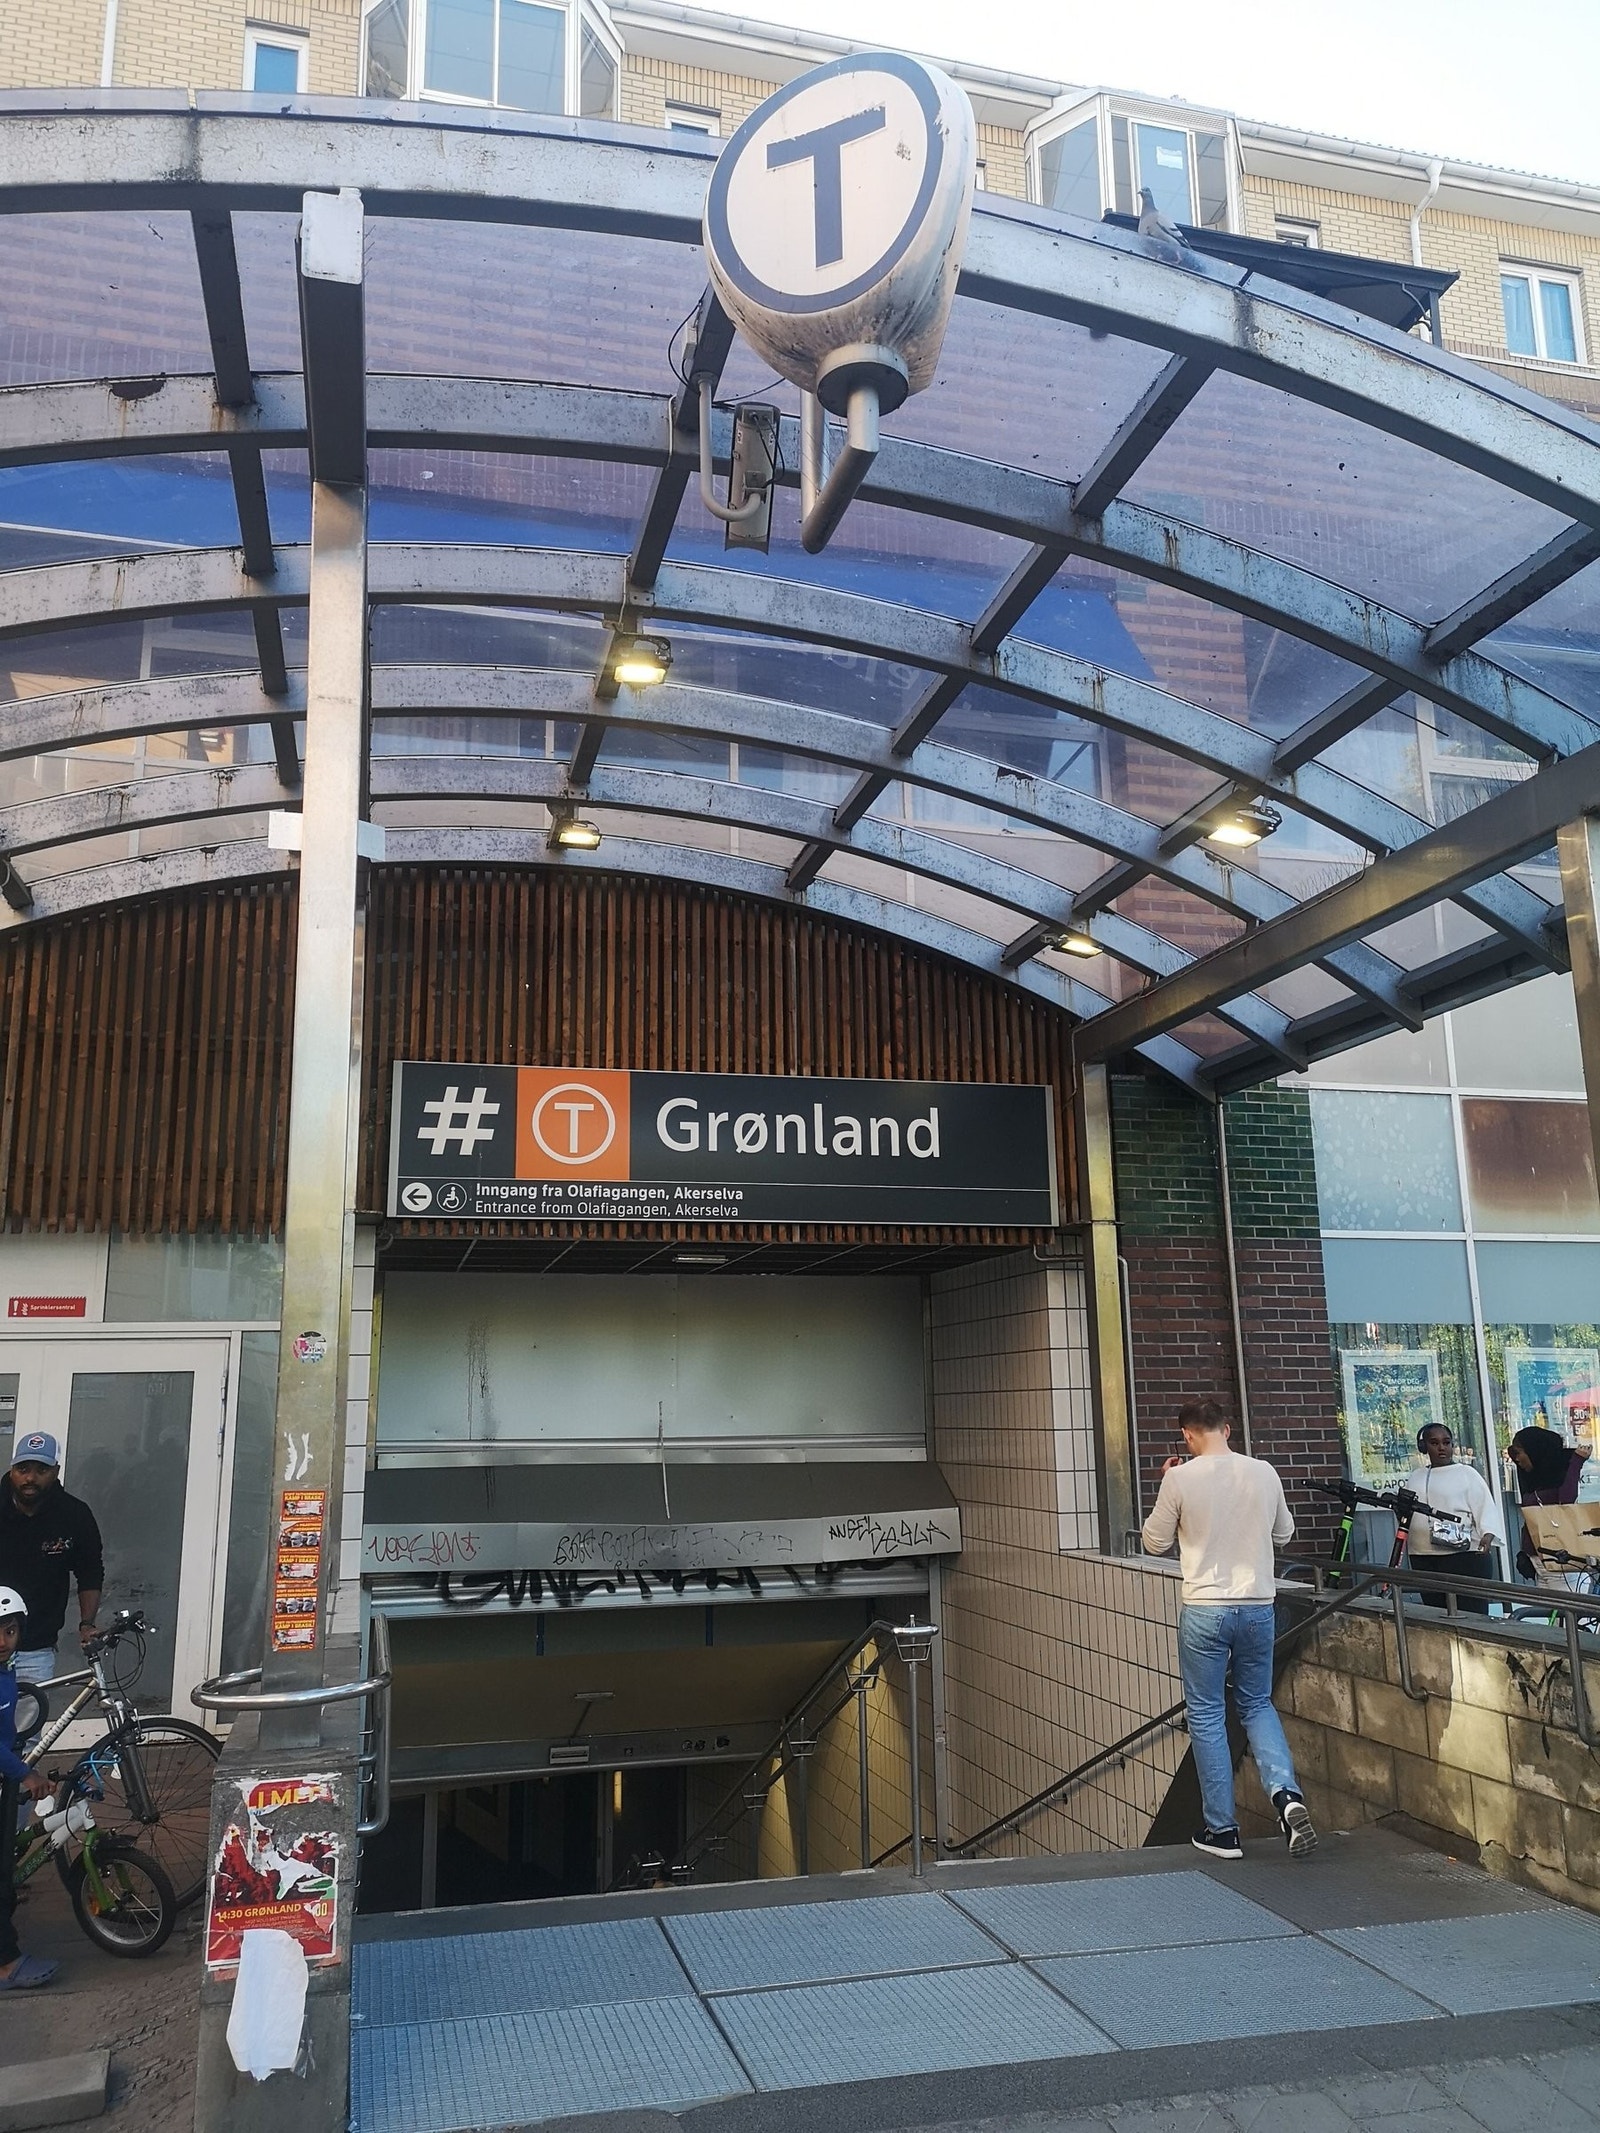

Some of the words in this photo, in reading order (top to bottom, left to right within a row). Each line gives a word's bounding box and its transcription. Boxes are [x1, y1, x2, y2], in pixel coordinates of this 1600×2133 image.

[766, 102, 887, 270] T
[553, 1102, 595, 1154] T
[655, 1096, 942, 1159] Grønland
[475, 1200, 536, 1214] Entrance
[540, 1201, 573, 1214] from
[577, 1202, 671, 1218] Olafiagangen,
[675, 1204, 739, 1217] Akerselva
[476, 1183, 538, 1199] Inngang
[542, 1184, 563, 1197] fra
[567, 1185, 669, 1202] Olafiagangen,
[673, 1186, 744, 1200] Akerselva
[244, 1903, 302, 1917] GRØNLAND
